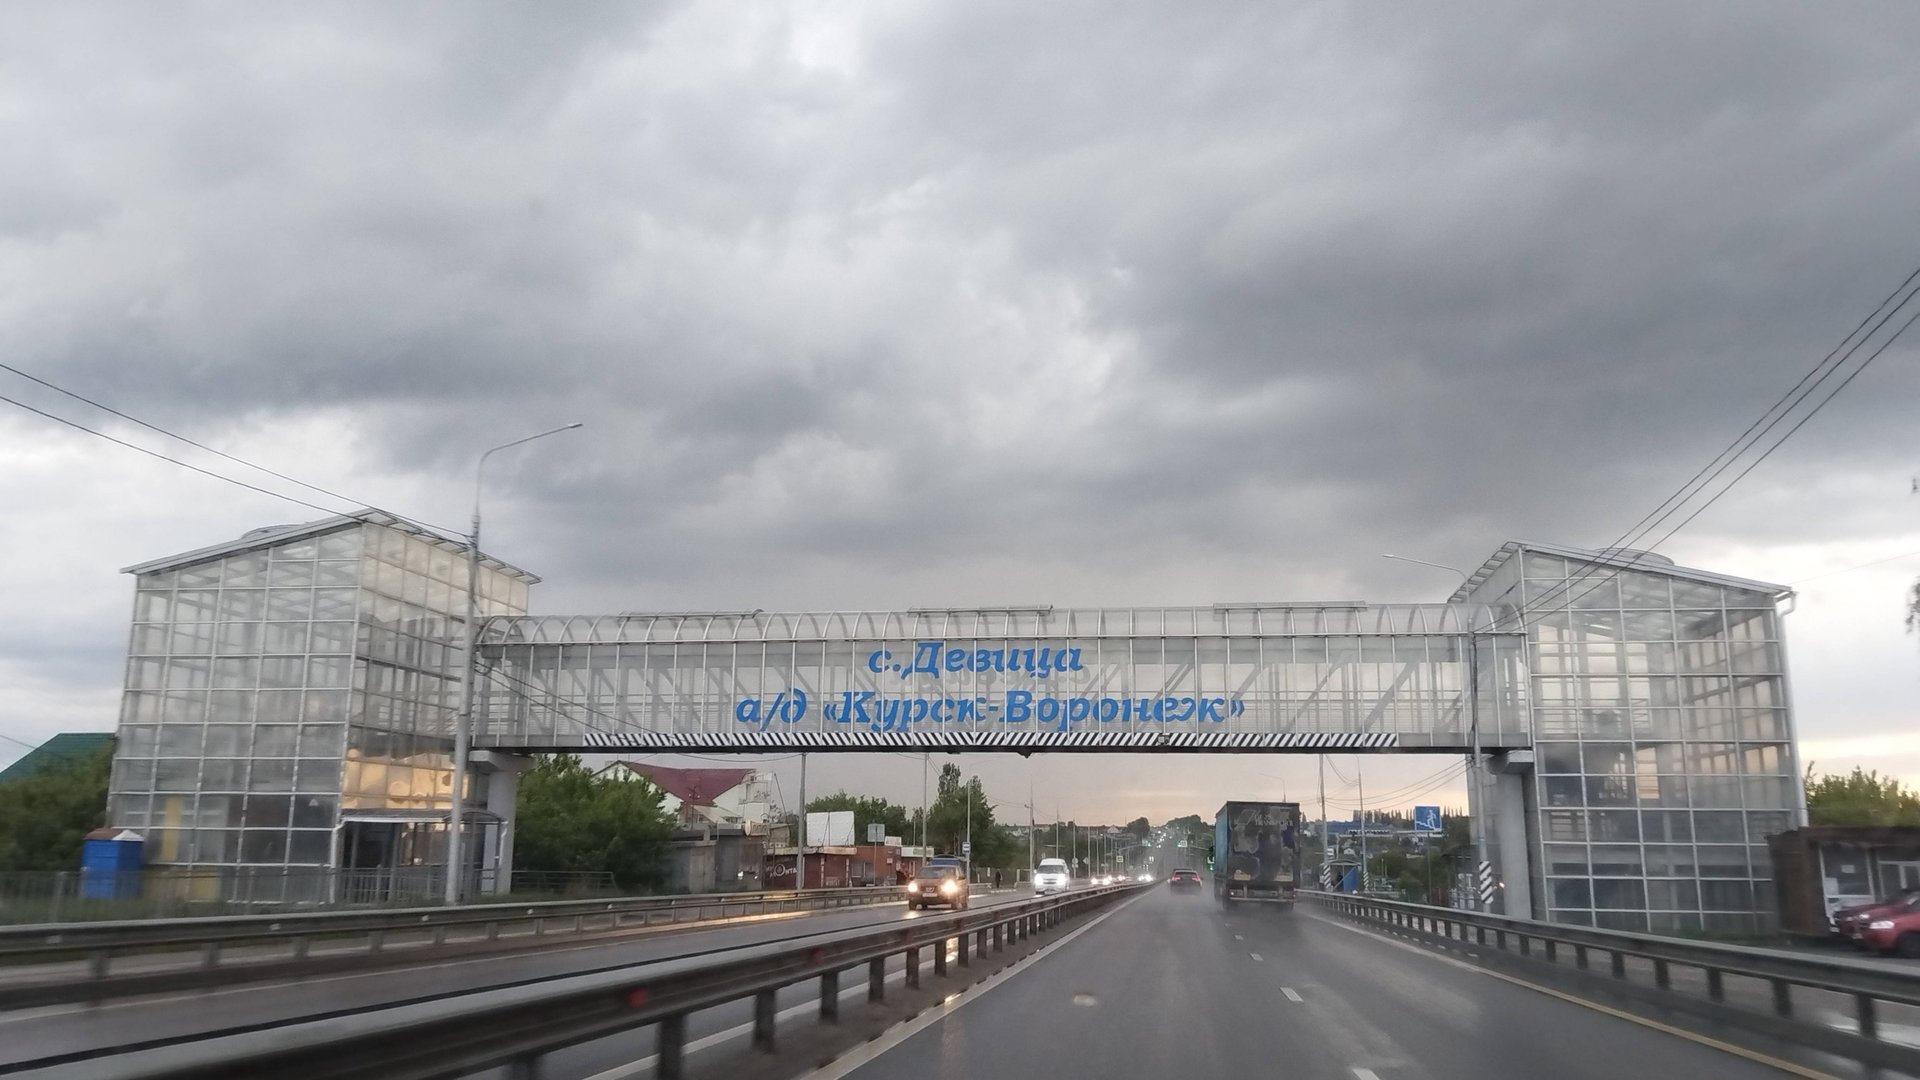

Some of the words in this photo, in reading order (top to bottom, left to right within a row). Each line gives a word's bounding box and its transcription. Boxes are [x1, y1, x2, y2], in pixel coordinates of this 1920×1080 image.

[867, 642, 1082, 677] с.Девица
[735, 687, 807, 732] а/д
[823, 688, 1245, 733] «Курск-Воронеж»
